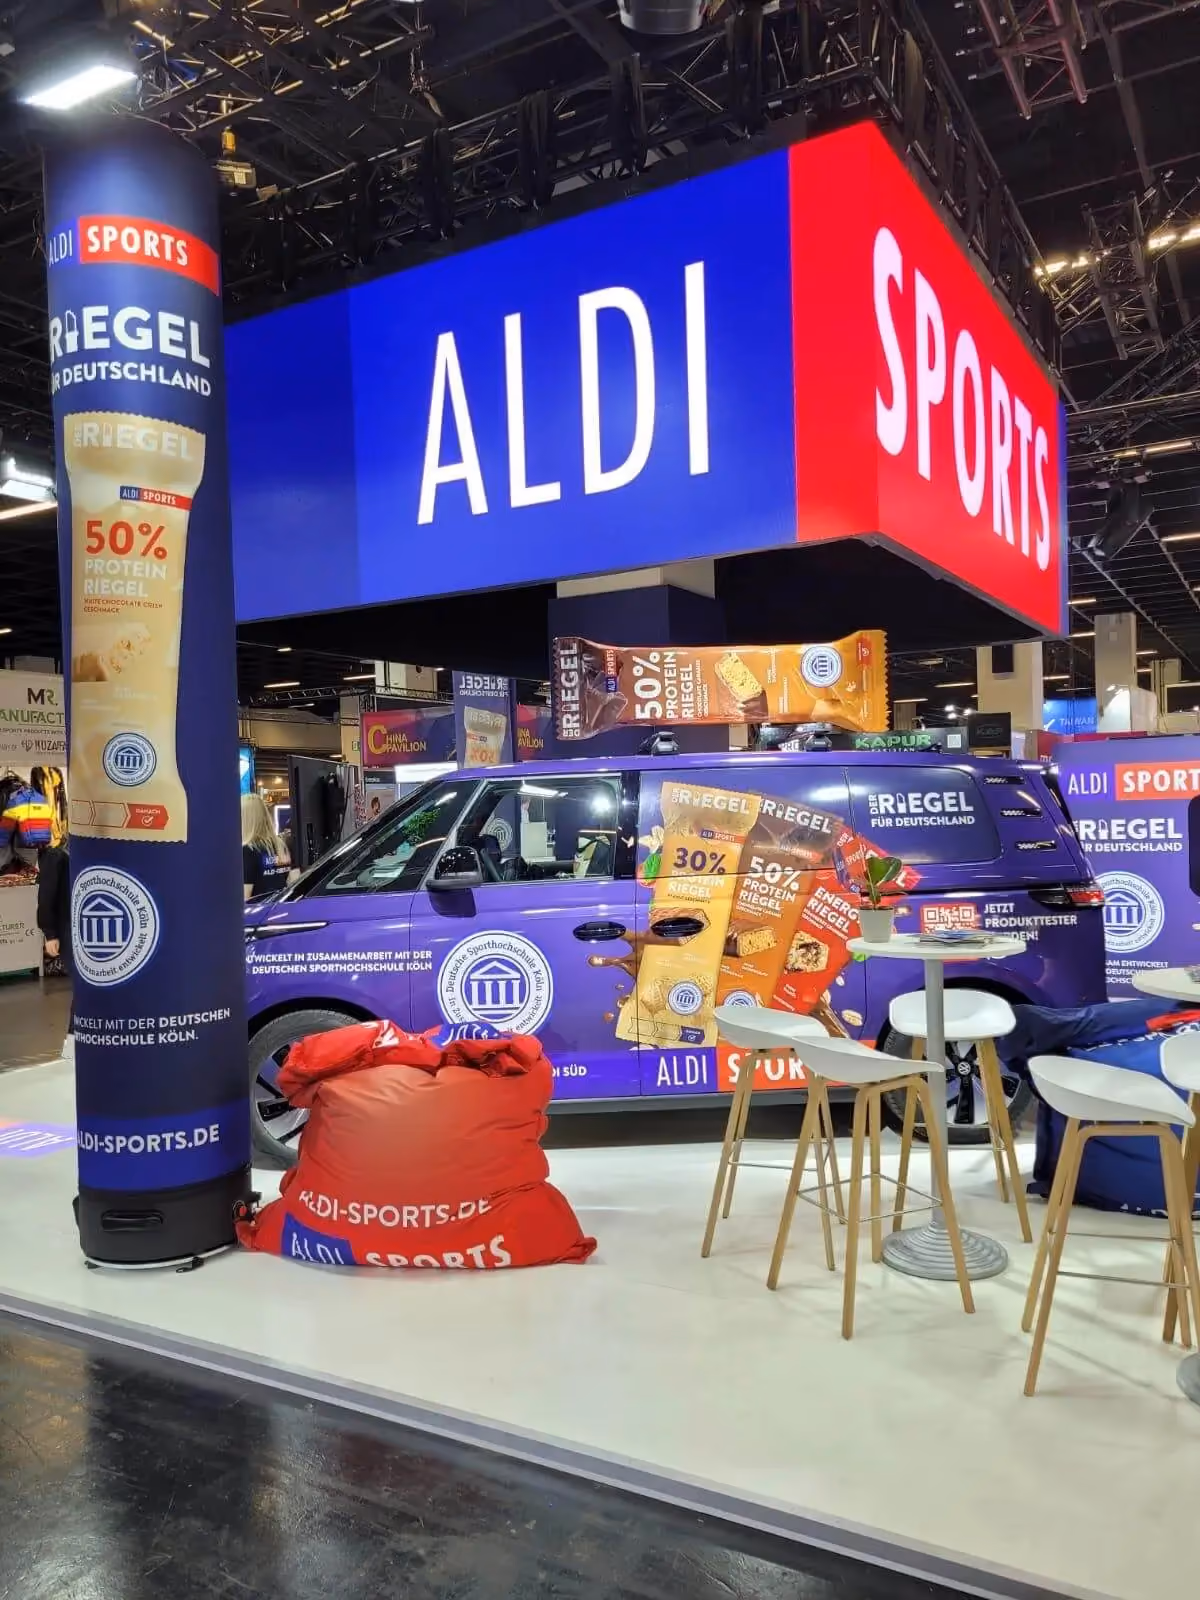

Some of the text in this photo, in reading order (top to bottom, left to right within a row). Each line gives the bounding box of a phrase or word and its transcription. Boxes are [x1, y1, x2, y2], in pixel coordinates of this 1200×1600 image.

[49, 225, 188, 268] ALDI SPORTS
[63, 361, 211, 397] DEUTSCHLAND
[417, 226, 1050, 572] ALDI SPORTS
[83, 421, 193, 461] RIEGEL
[122, 487, 177, 505] ALDI SPORTS
[86, 520, 168, 560] 50%
[84, 559, 168, 580] PROTEIN
[84, 578, 149, 598] RIEGEL
[606, 649, 614, 676] SPORTS
[560, 642, 580, 728] RIEGEL
[632, 651, 663, 719] 50%
[664, 652, 678, 719] PROTEIN
[680, 663, 694, 720] RIEGEL
[368, 724, 408, 754] CHINA
[386, 741, 427, 753] PAVILION
[855, 735, 931, 748] KAPUR
[1068, 772, 1108, 795] ALDI
[680, 788, 750, 815] RIEGEL
[869, 791, 974, 815] DER RIEGEL
[762, 798, 832, 835] RIEGEL
[871, 816, 976, 828] FÜR DEUTSCHLAND
[1080, 818, 1183, 840] RIEGEL
[673, 847, 726, 875] 30%
[1095, 842, 1183, 853] DEUTSCHLAND
[749, 855, 800, 891] 50%
[80, 875, 149, 929] Sporthochschule Köln
[668, 880, 712, 898] RIEGEL
[739, 889, 781, 911] RIEGEL
[743, 878, 796, 904] PROTEIN
[807, 897, 850, 933] RIEGEL
[984, 902, 1015, 914] JETZT
[985, 915, 1078, 929] PRODUKTTESTER
[118, 932, 148, 971] entwickelt
[295, 954, 304, 962] IN
[307, 953, 392, 962] ZUSAMMENARBEIT
[395, 952, 410, 960] MIT
[413, 951, 432, 960] DER
[252, 960, 432, 975] DEUTSCHEN SPORTHOCHSCHULE KÖLN
[446, 940, 544, 993] Deutsche Sporthochschule Köln
[105, 1018, 125, 1031] MIT
[128, 1018, 156, 1031] DER
[159, 1008, 231, 1029] DEUTSCHEN
[515, 995, 543, 1031] entwickelt
[158, 1029, 199, 1044] KÖLN.
[563, 1064, 588, 1077] SÜD
[656, 1054, 708, 1087] ALDI
[299, 1189, 493, 1228] ALDI-SPORTS.DE
